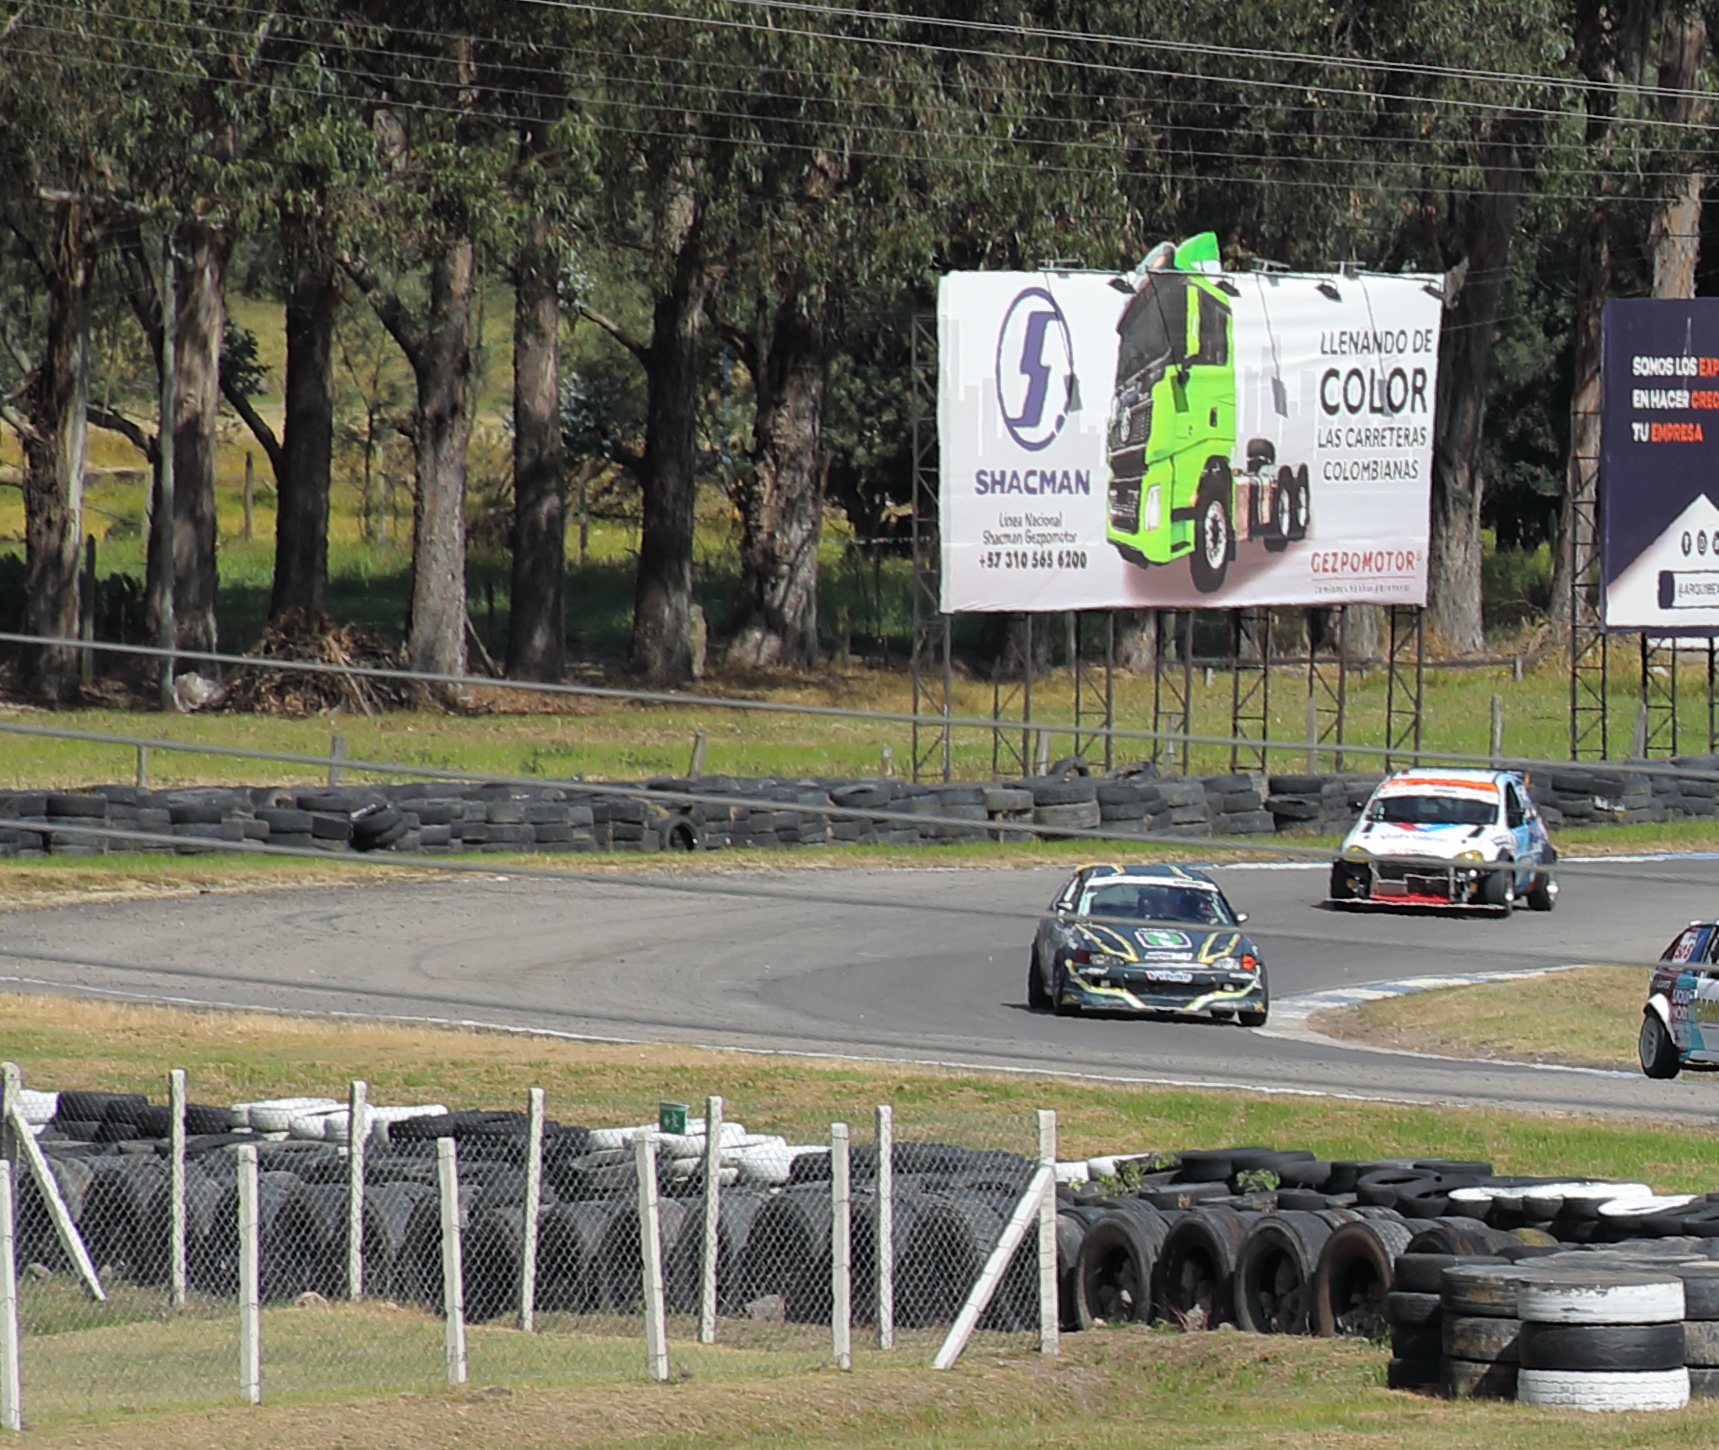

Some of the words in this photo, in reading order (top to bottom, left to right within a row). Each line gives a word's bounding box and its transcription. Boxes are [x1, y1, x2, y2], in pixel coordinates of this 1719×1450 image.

[1320, 329, 1408, 355] LLENANDO
[1413, 328, 1433, 353] DE
[1632, 355, 1675, 376] SOMOS
[1675, 356, 1698, 376] LOS
[1320, 367, 1428, 416] COLOR
[1632, 389, 1649, 409] EN
[1650, 388, 1690, 410] HACER
[1317, 427, 1342, 449] LAS
[1345, 426, 1427, 448] CARRETERAS
[1631, 421, 1650, 442] TU
[1650, 422, 1704, 443] EMPRESA
[1323, 459, 1419, 481] COLOMBIANAS
[974, 468, 1091, 496] SHACMAN
[1024, 510, 1063, 528] Nacional
[982, 528, 1024, 546] Shacman
[978, 550, 1001, 570] +57
[1005, 549, 1028, 569] 310
[1057, 549, 1087, 570] 6200
